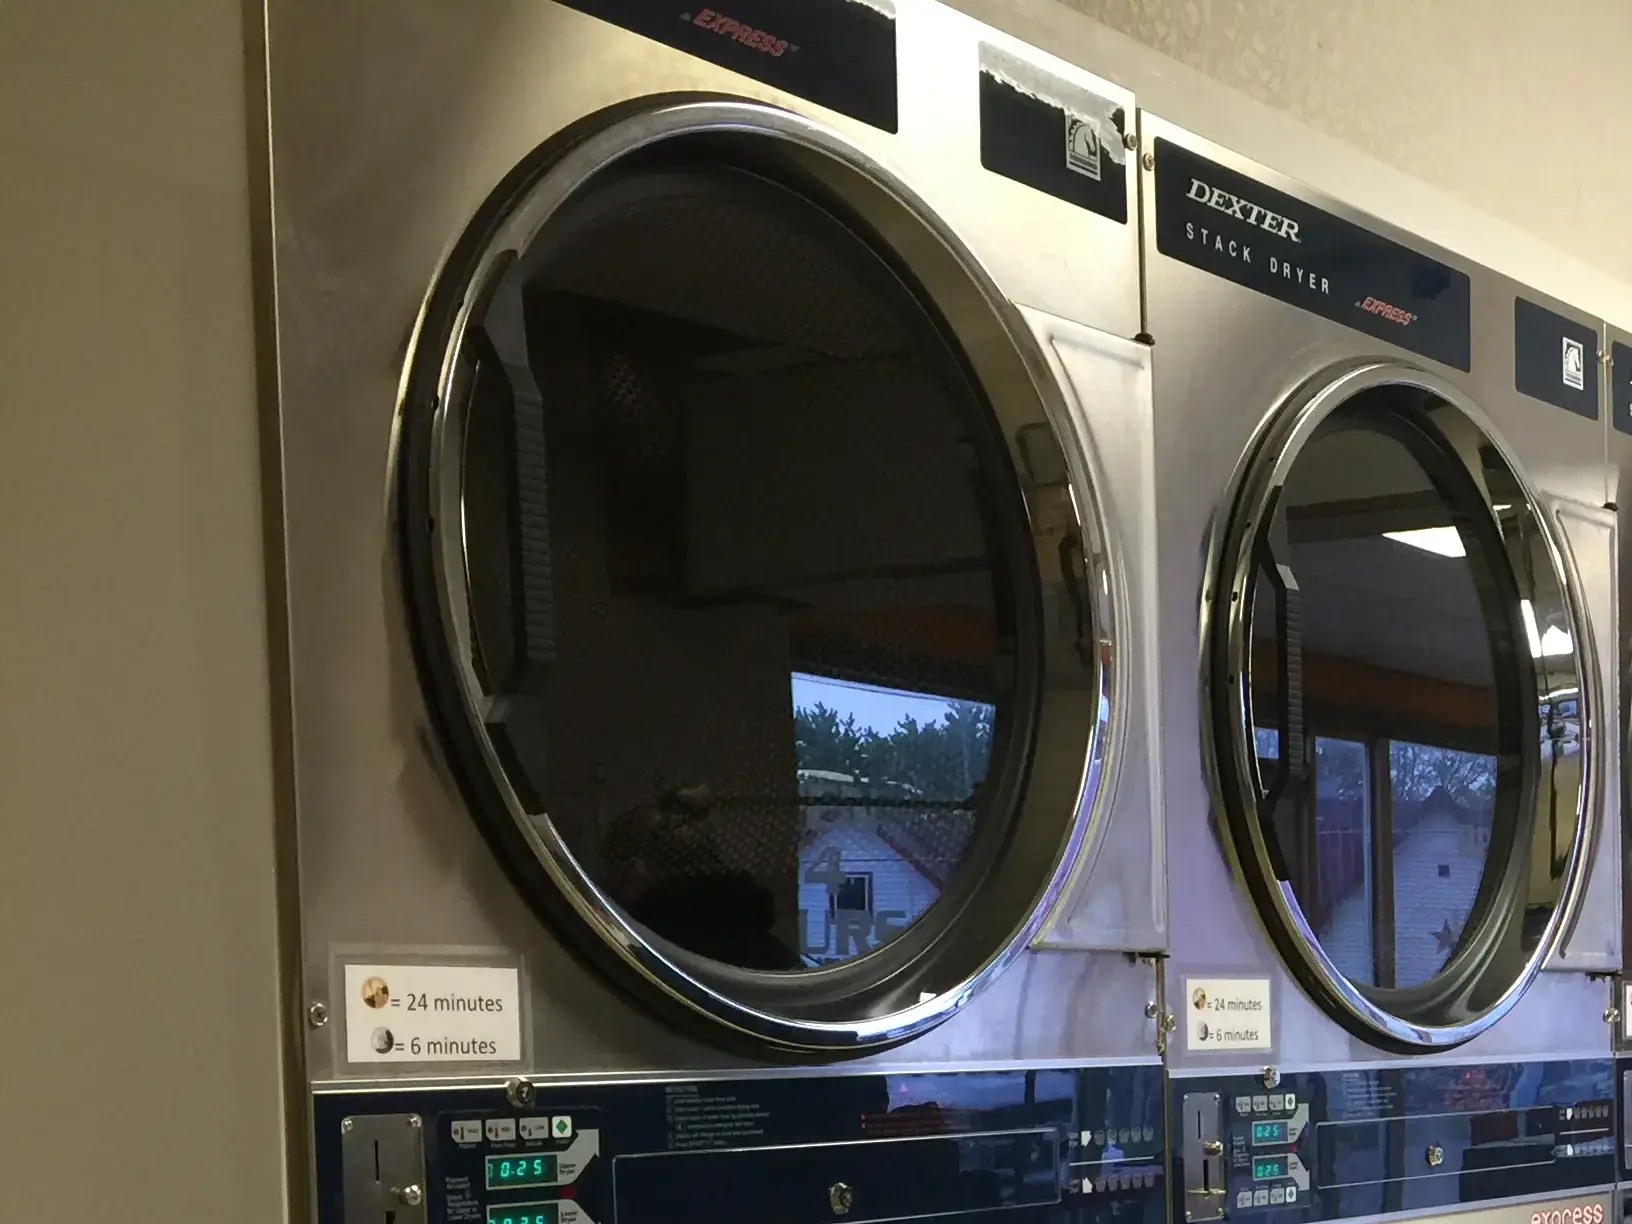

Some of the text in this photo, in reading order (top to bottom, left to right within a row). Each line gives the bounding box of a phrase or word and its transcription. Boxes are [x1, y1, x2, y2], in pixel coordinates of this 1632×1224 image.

[693, 8, 788, 57] EXPRESS
[1186, 178, 1301, 243] DEXTER
[1186, 221, 1330, 295] STACK DRYER
[1361, 296, 1412, 326] EXPRESS
[406, 994, 429, 1012] 24
[434, 994, 503, 1012] minutes
[1214, 998, 1225, 1011] 24
[1227, 998, 1262, 1011] minutes
[410, 1037, 421, 1055] 6
[427, 1037, 497, 1055] minutes
[1216, 1028, 1223, 1041] 6
[1224, 1028, 1259, 1041] minutes
